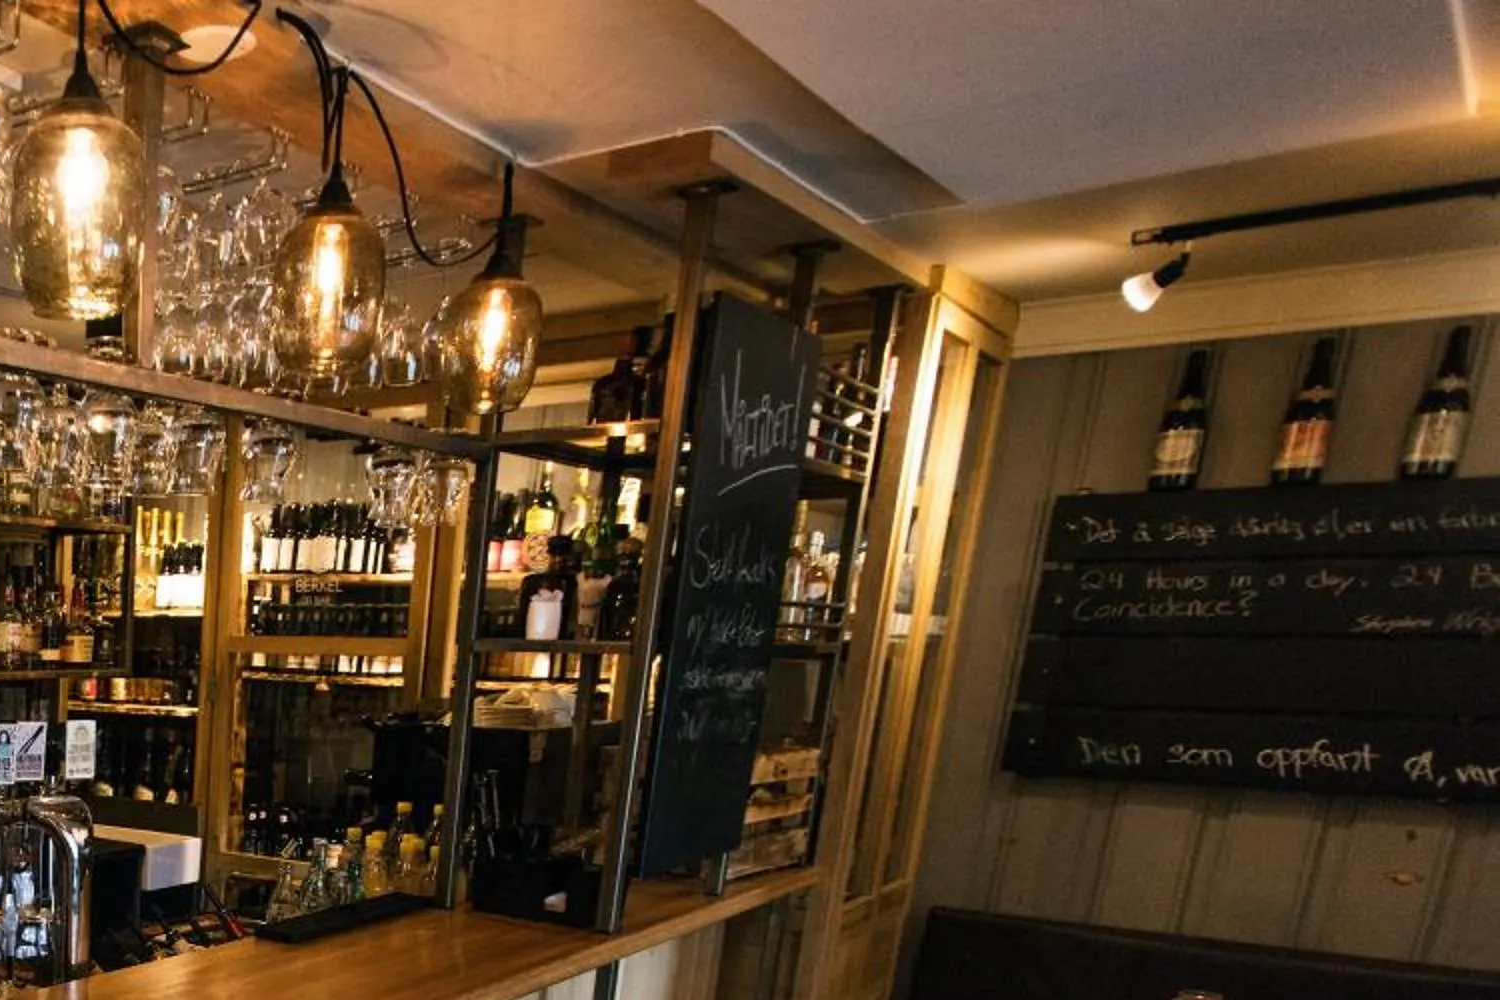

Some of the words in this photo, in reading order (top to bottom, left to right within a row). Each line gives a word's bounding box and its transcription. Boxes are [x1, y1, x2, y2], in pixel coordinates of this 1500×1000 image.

[1077, 736, 1142, 768] Den
[1164, 745, 1234, 769] som
[1256, 738, 1382, 779] oppfant
